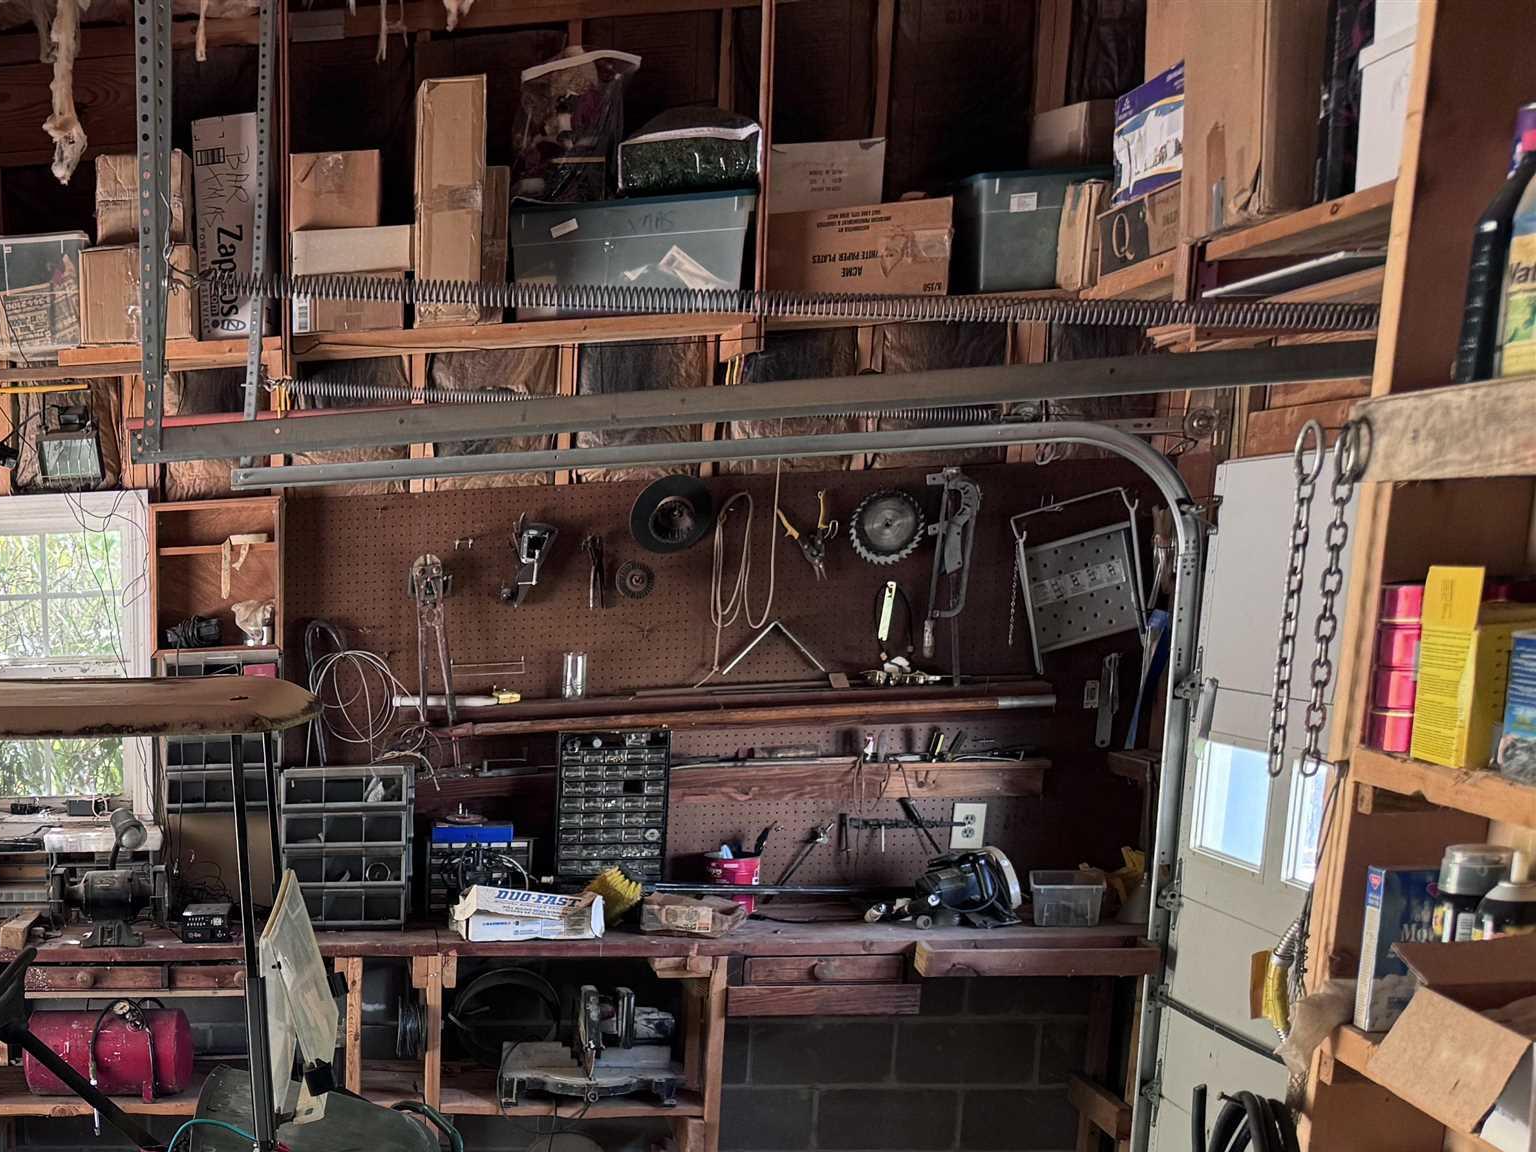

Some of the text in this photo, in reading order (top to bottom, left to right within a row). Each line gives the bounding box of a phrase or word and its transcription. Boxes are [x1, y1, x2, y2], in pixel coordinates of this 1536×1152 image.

[226, 145, 250, 203] BAR
[812, 253, 837, 264] PLATES
[838, 252, 860, 262] PAPER
[840, 265, 863, 279] ACME
